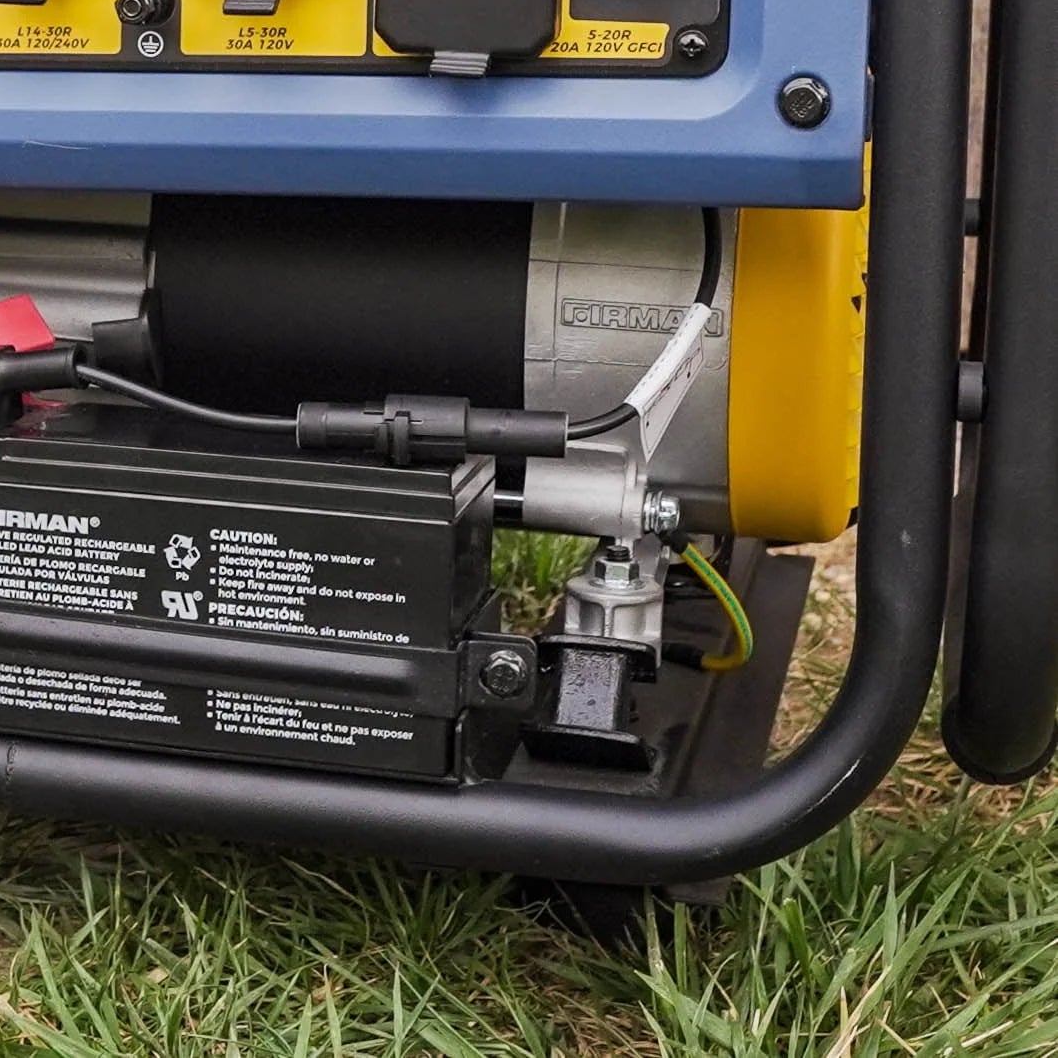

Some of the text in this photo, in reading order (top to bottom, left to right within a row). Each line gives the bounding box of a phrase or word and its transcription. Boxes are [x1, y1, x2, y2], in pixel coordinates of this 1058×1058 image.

[17, 26, 72, 38] L14-30R
[239, 27, 287, 39] L5-30R
[587, 30, 631, 41] 5-20R
[27, 37, 89, 50] 120/240V
[226, 39, 294, 50] 30A 120V
[550, 42, 663, 54] 20A 120V GFCI
[13, 532, 72, 545] REGULATED
[74, 538, 155, 554] RECHARGEABLE
[210, 529, 277, 545] CAUTION:
[19, 543, 45, 553] LEAD
[47, 546, 72, 556] ACID
[74, 549, 120, 561] BATTERY
[219, 543, 286, 558] Maintenance
[289, 549, 312, 561] free,
[331, 555, 360, 565] water
[24, 557, 37, 566] DE
[39, 559, 76, 572] PLOMO
[79, 563, 145, 577] RECARGABLE
[219, 555, 314, 574] electrolyte supply;
[35, 569, 55, 579] POR
[58, 571, 110, 584] VÁLVULAS
[176, 571, 190, 581] Pb
[219, 566, 310, 584] Do not incinerate;
[28, 581, 106, 597] RECHARGEABLE
[109, 589, 138, 601] SANS
[218, 588, 306, 605] hot environment.
[219, 577, 405, 603] Keep fire away and do not expose in
[35, 593, 49, 601] AU
[52, 594, 123, 609] PLOMB-ACIDE
[125, 599, 134, 610] À
[209, 602, 304, 621] PRECAUCIÓN:
[218, 617, 409, 643] Sin mantenimiento, sin suministro de
[26, 676, 73, 689] desechada
[75, 682, 87, 691] de
[90, 683, 117, 695] forma
[119, 687, 167, 699] adecuada.
[27, 690, 47, 699] sans
[50, 693, 91, 706] entretien
[107, 698, 165, 714] plomb-acide
[216, 699, 231, 711] Ne
[233, 703, 251, 715] pas
[254, 703, 302, 719] incinérer;
[216, 710, 413, 739] Tenir à l'écart du feu et ne pas exposer
[216, 722, 355, 745] à un environnement chaud.
